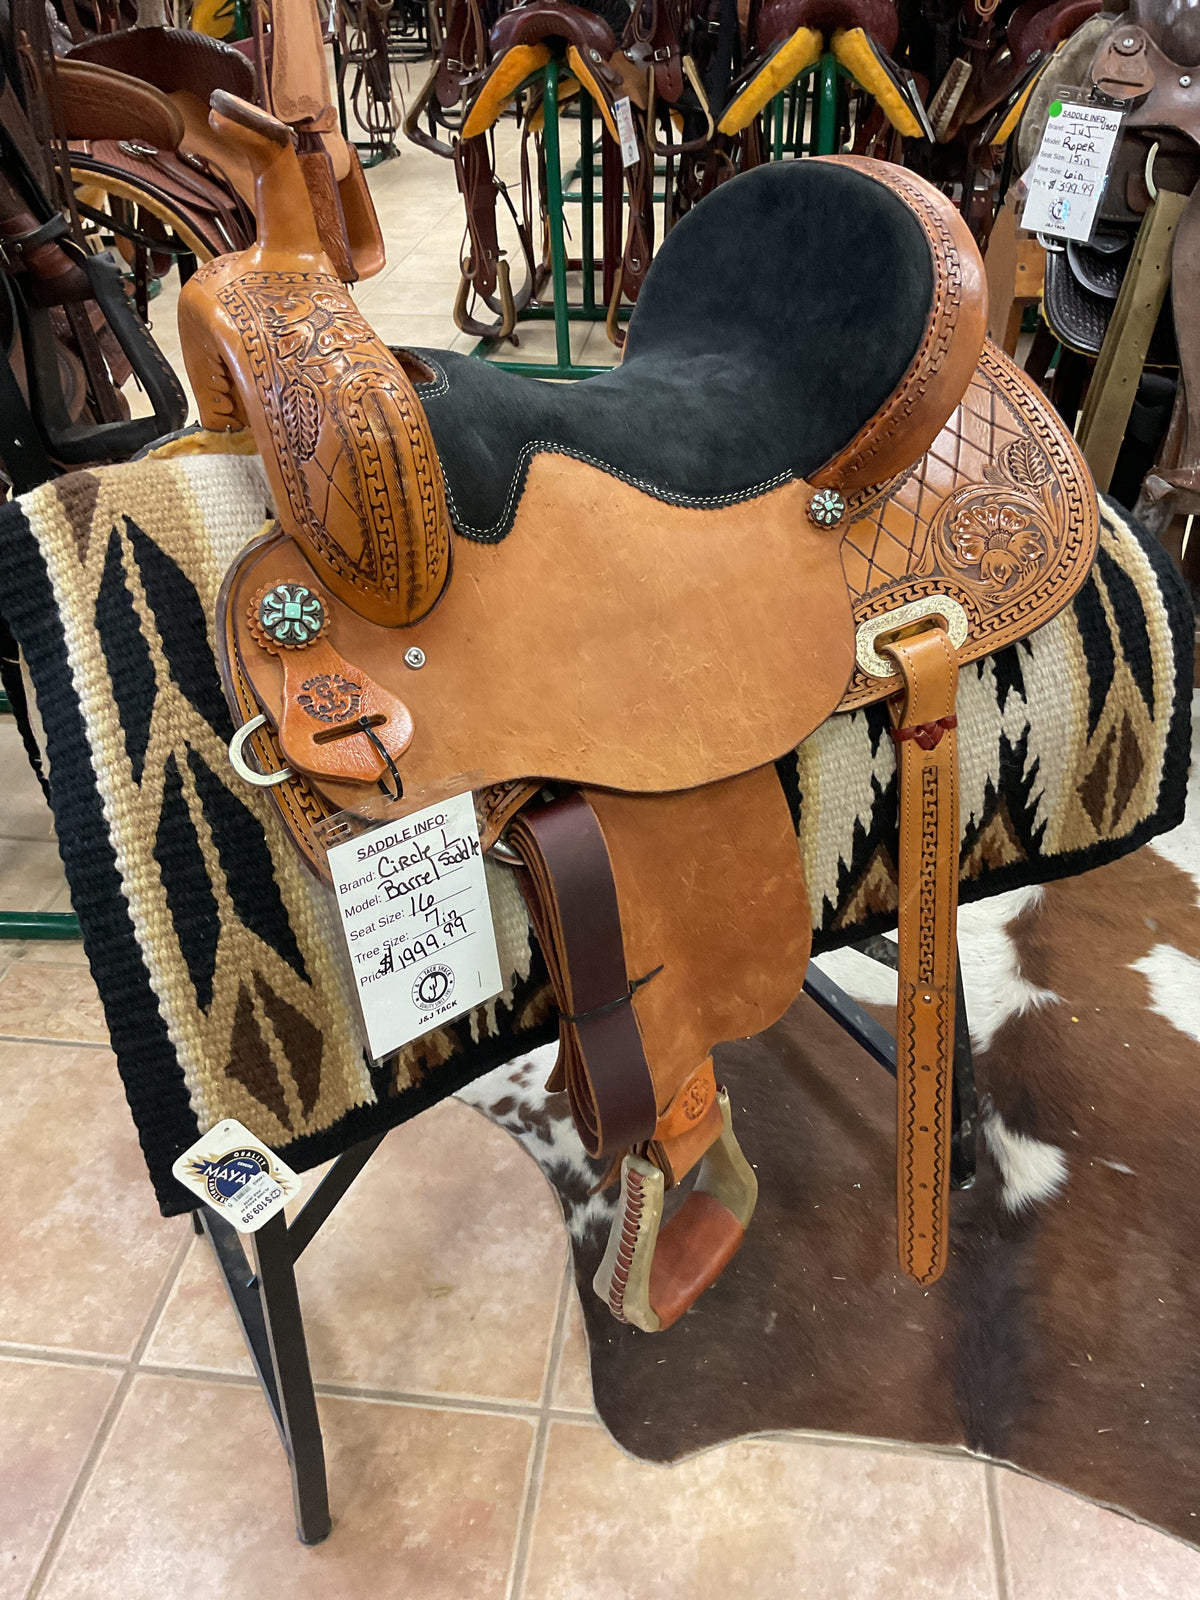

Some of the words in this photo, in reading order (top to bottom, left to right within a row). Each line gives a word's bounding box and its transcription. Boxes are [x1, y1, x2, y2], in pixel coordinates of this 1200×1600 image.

[1062, 110, 1089, 121] SADDLE
[357, 827, 412, 860] SADDLE
[413, 813, 448, 836] INFO:
[339, 871, 377, 895] Brand:
[441, 829, 461, 849] L
[344, 894, 382, 918] Model:
[377, 856, 441, 901] Barrel
[438, 835, 480, 866] Saddle
[350, 922, 376, 941] Seat
[378, 909, 405, 928] Size:
[411, 892, 434, 917] 16
[355, 947, 380, 963] Tree
[382, 932, 409, 949] Size:
[425, 907, 458, 926] 7in
[423, 965, 437, 976] TACK
[418, 1011, 434, 1025] J&J
[436, 1000, 458, 1015] TACK
[233, 1151, 268, 1167] QUALITY
[241, 1196, 273, 1224] $109.99
